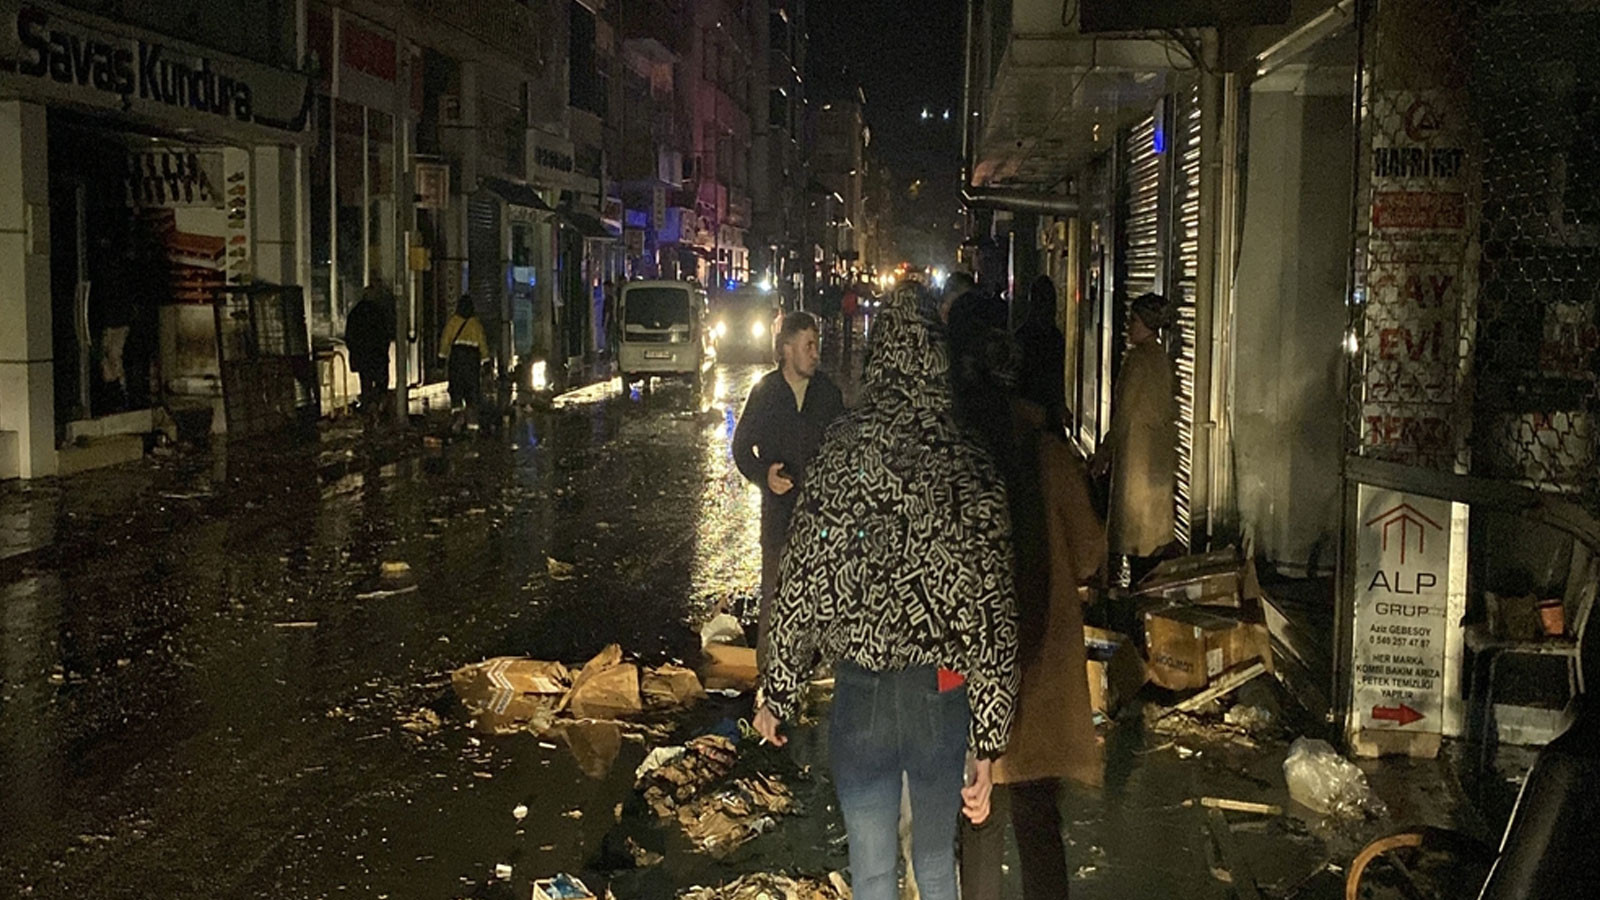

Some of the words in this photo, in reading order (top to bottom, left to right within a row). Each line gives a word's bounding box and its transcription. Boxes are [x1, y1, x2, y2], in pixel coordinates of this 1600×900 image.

[139, 41, 251, 121] Kundura
[1368, 570, 1437, 595] ALP
[1375, 602, 1429, 617] GRUP
[1393, 655, 1424, 665] MARKA
